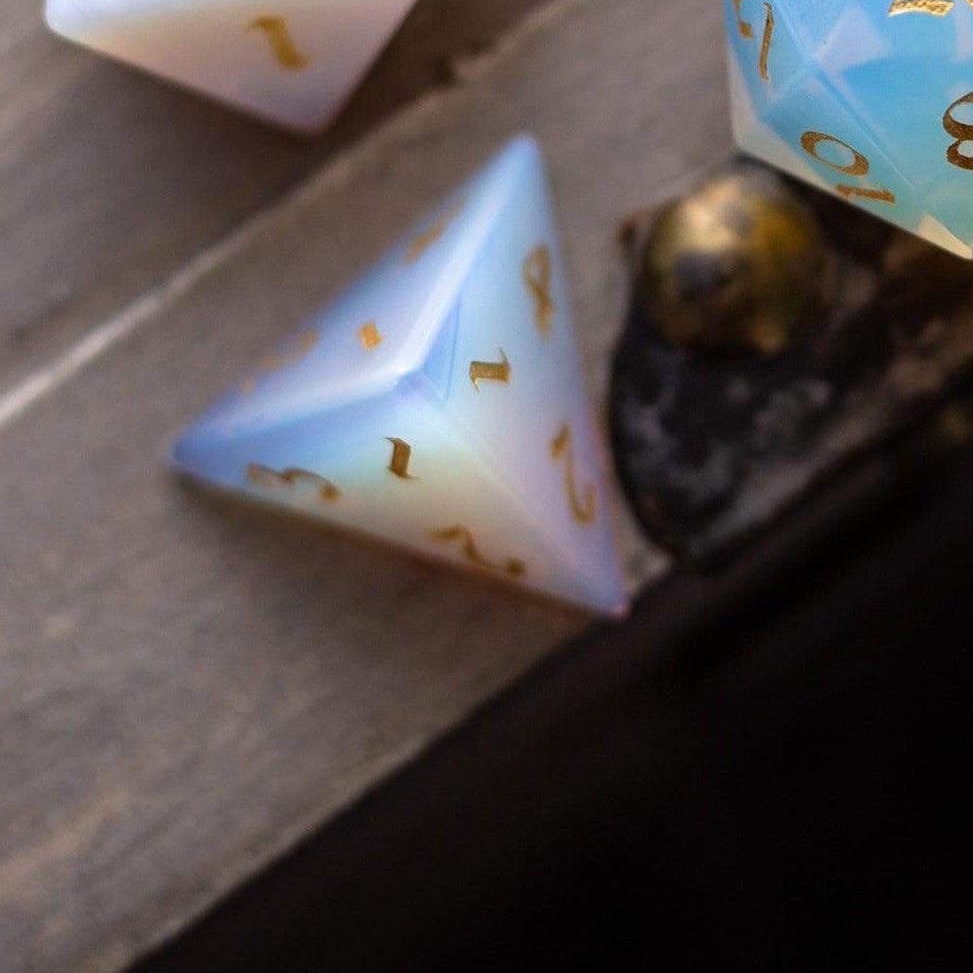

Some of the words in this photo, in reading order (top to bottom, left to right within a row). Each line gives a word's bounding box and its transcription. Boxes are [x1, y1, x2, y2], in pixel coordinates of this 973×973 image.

[800, 131, 896, 205] 10
[469, 343, 512, 393] 1
[384, 436, 421, 482] 1
